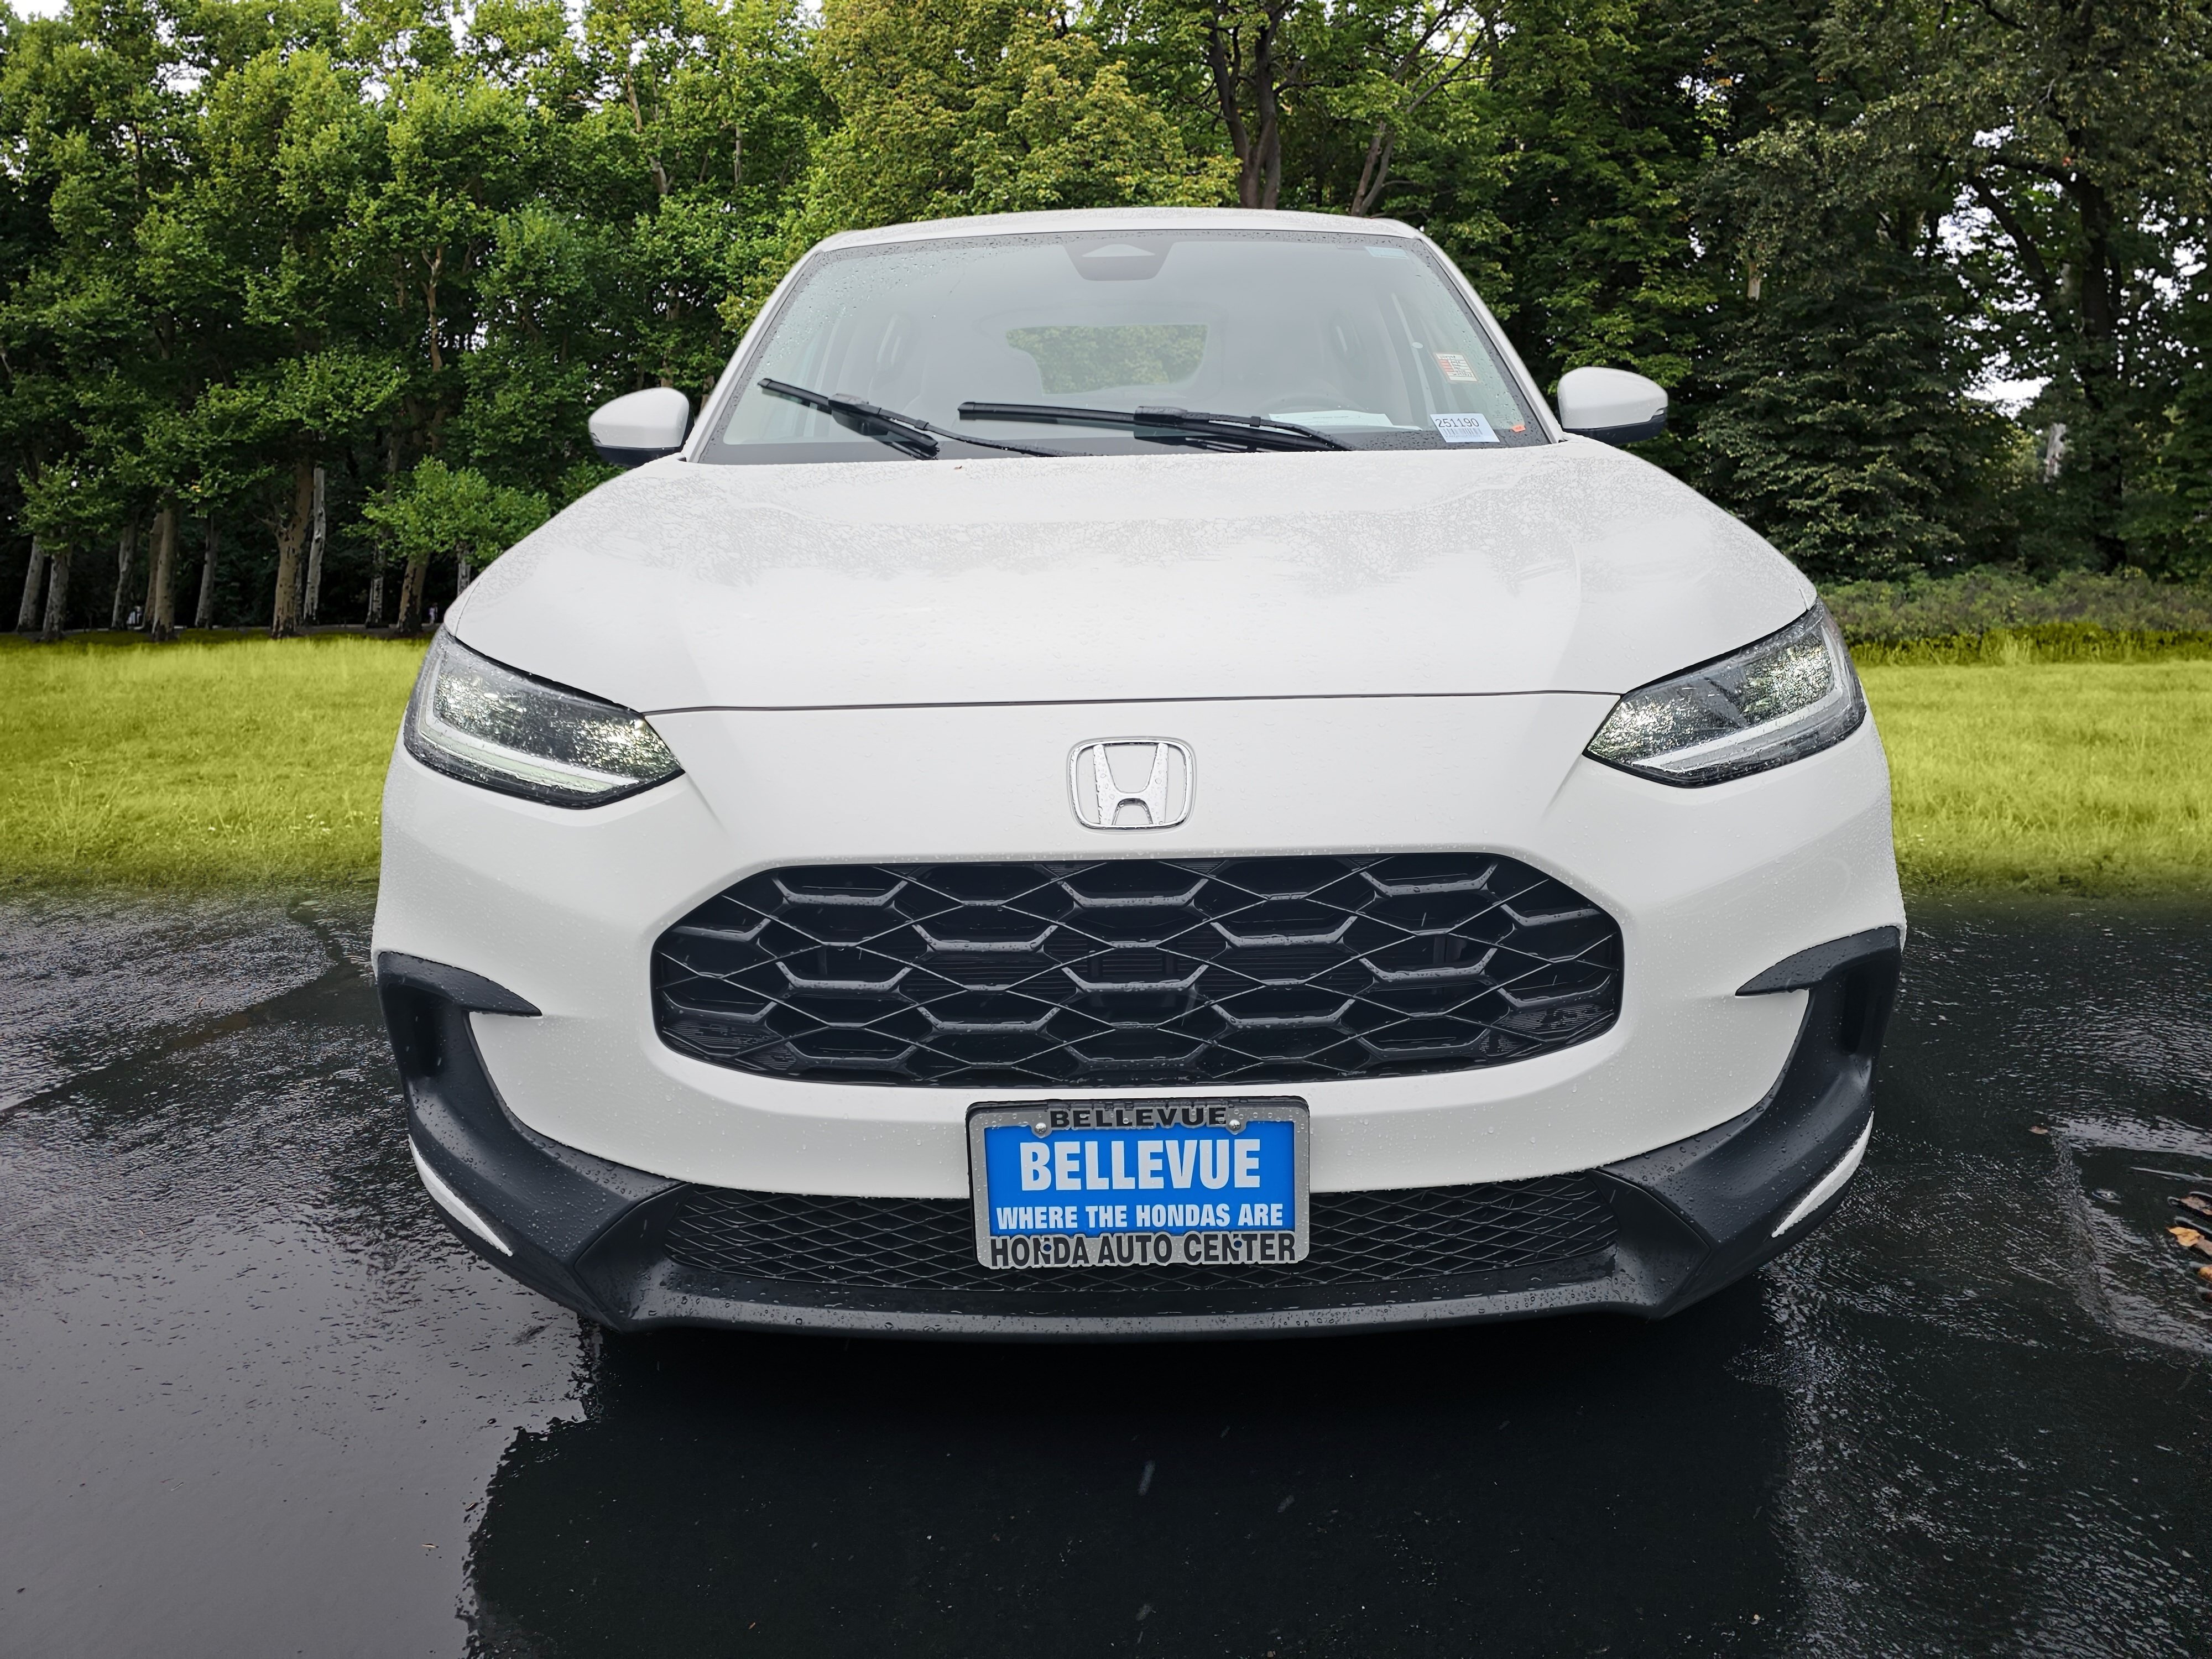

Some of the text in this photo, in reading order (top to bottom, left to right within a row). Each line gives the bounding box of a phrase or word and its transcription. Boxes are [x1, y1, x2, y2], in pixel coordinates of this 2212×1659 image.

[1435, 418, 1479, 427] 251190
[1050, 1107, 1226, 1128] BELLEVUE
[1020, 1139, 1260, 1191] BELLEVUE
[997, 1203, 1283, 1229] WHERE THE HONDAS ARE
[990, 1233, 1295, 1266] HONDA AUTO CENTER
